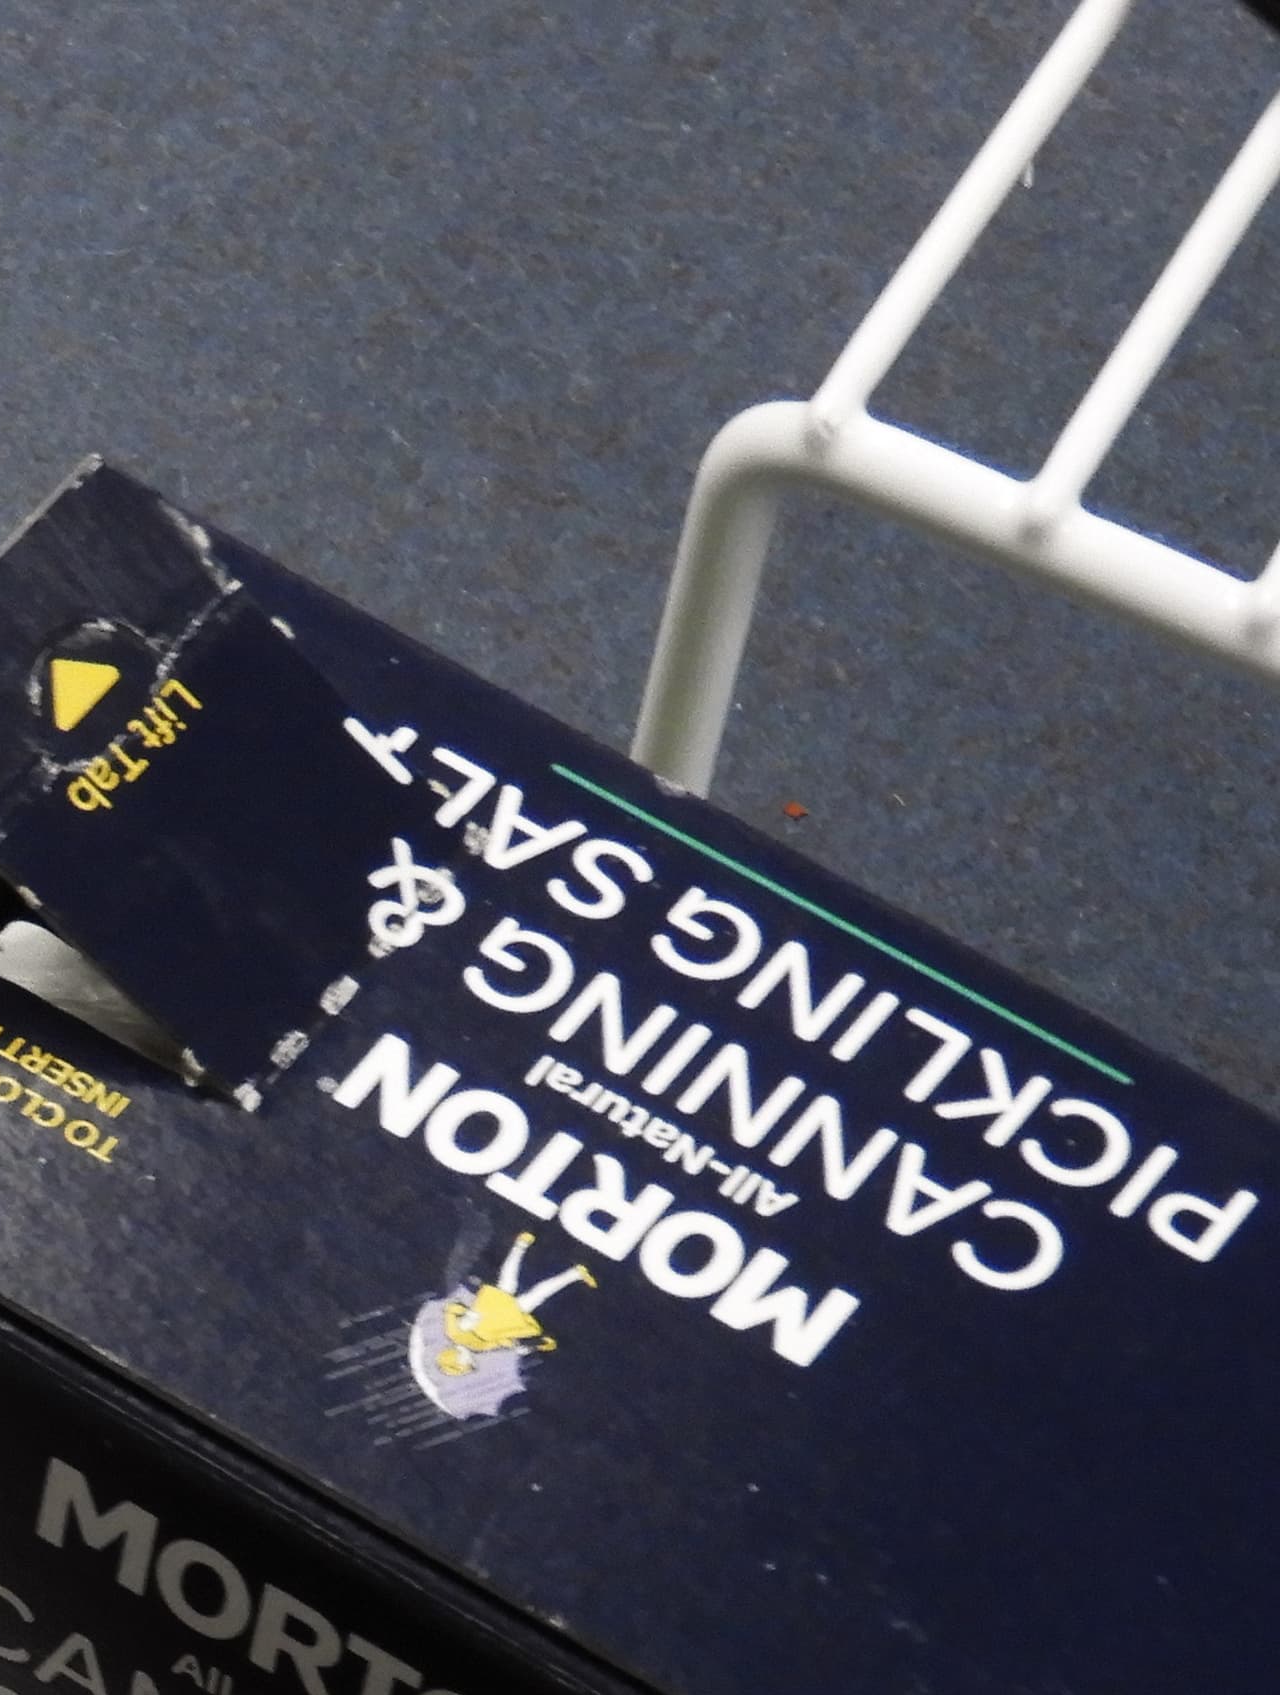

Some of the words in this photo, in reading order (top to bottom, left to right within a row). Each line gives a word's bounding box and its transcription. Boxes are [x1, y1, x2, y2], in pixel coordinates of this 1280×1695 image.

[64, 738, 149, 814] Tab
[124, 678, 204, 749] Lift
[343, 716, 653, 920] SALT
[366, 837, 466, 947] &
[58, 1111, 123, 1167] TO
[462, 916, 1065, 1292] CANNING
[524, 1054, 801, 1218] All-Natural
[650, 888, 1258, 1263] PICKLING
[331, 1032, 861, 1368] MORTON
